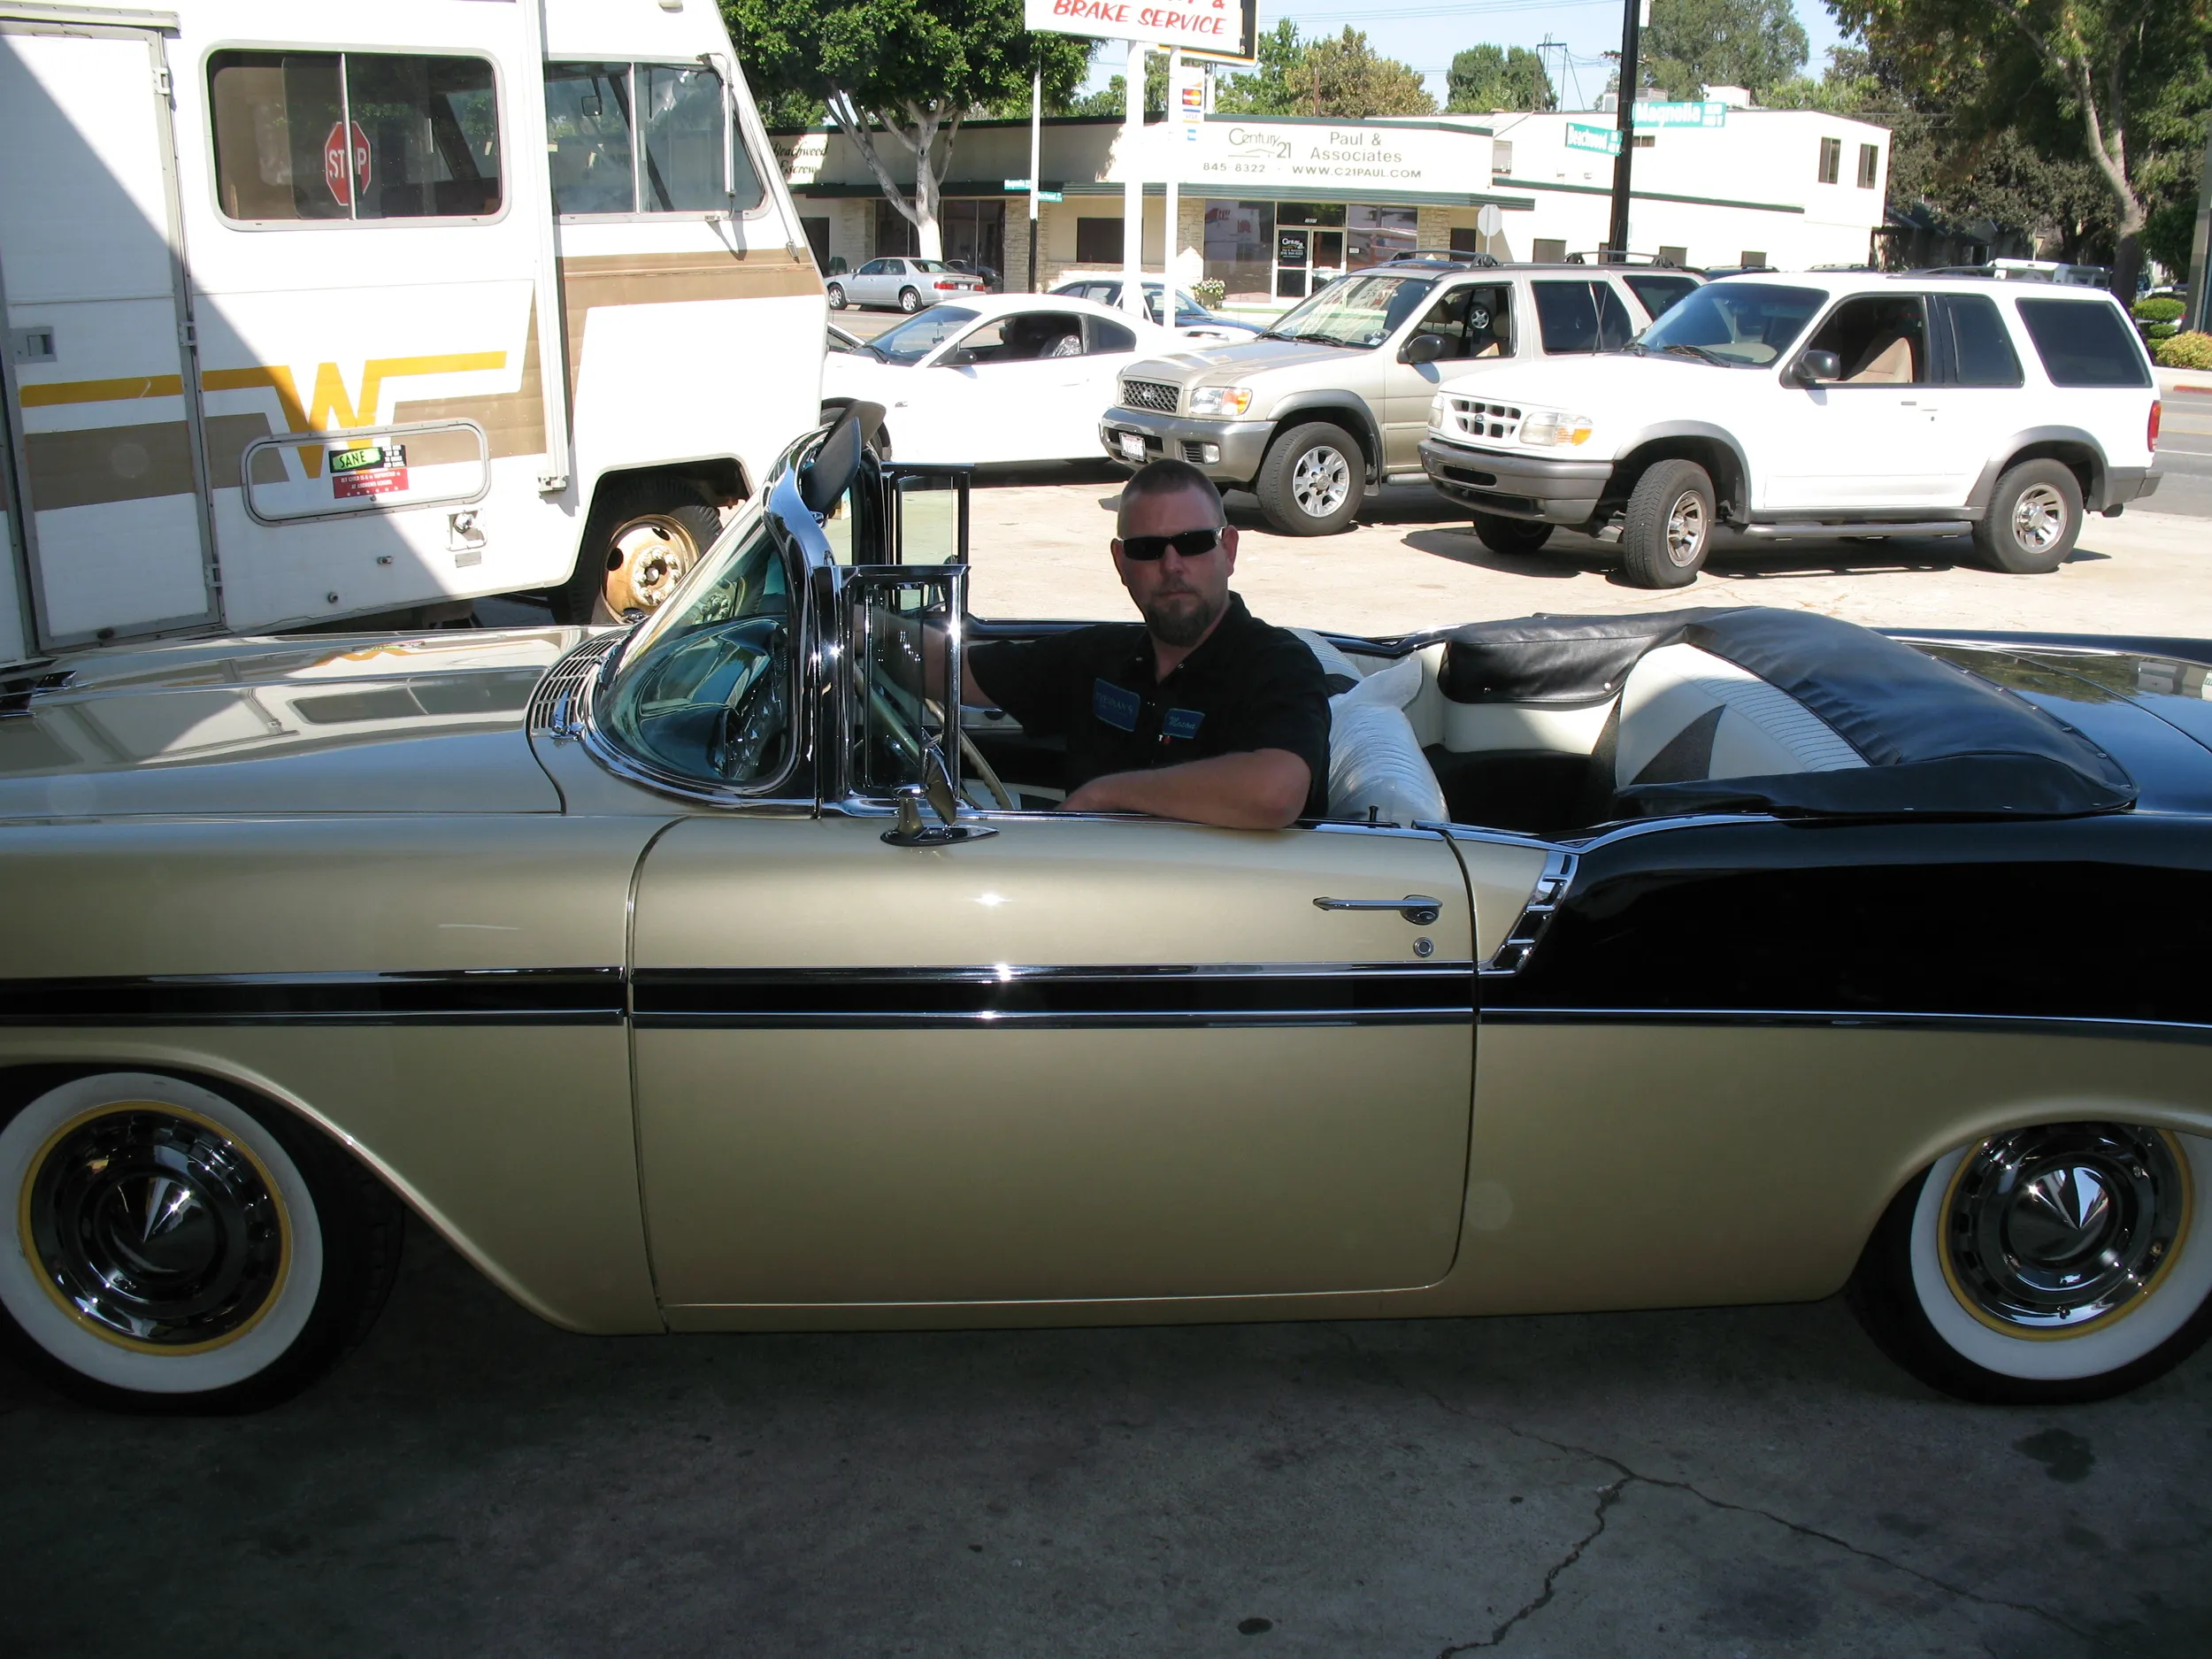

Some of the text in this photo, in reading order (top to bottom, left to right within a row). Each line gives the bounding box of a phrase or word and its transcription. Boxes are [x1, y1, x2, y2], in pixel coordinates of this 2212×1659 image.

[1053, 0, 1227, 35] BRAKE SERVICE
[1637, 103, 1701, 127] Magnolia
[1228, 127, 1292, 159] Century 21
[1330, 131, 1382, 146] Paul &
[774, 141, 829, 157] Beachwood
[1310, 147, 1402, 163] Associates
[328, 147, 367, 179] STP
[780, 159, 816, 175] Escrow
[1292, 165, 1422, 179] WWW.C21PAUL.COM
[339, 450, 366, 469] SANE
[1168, 715, 1196, 730] Mason
